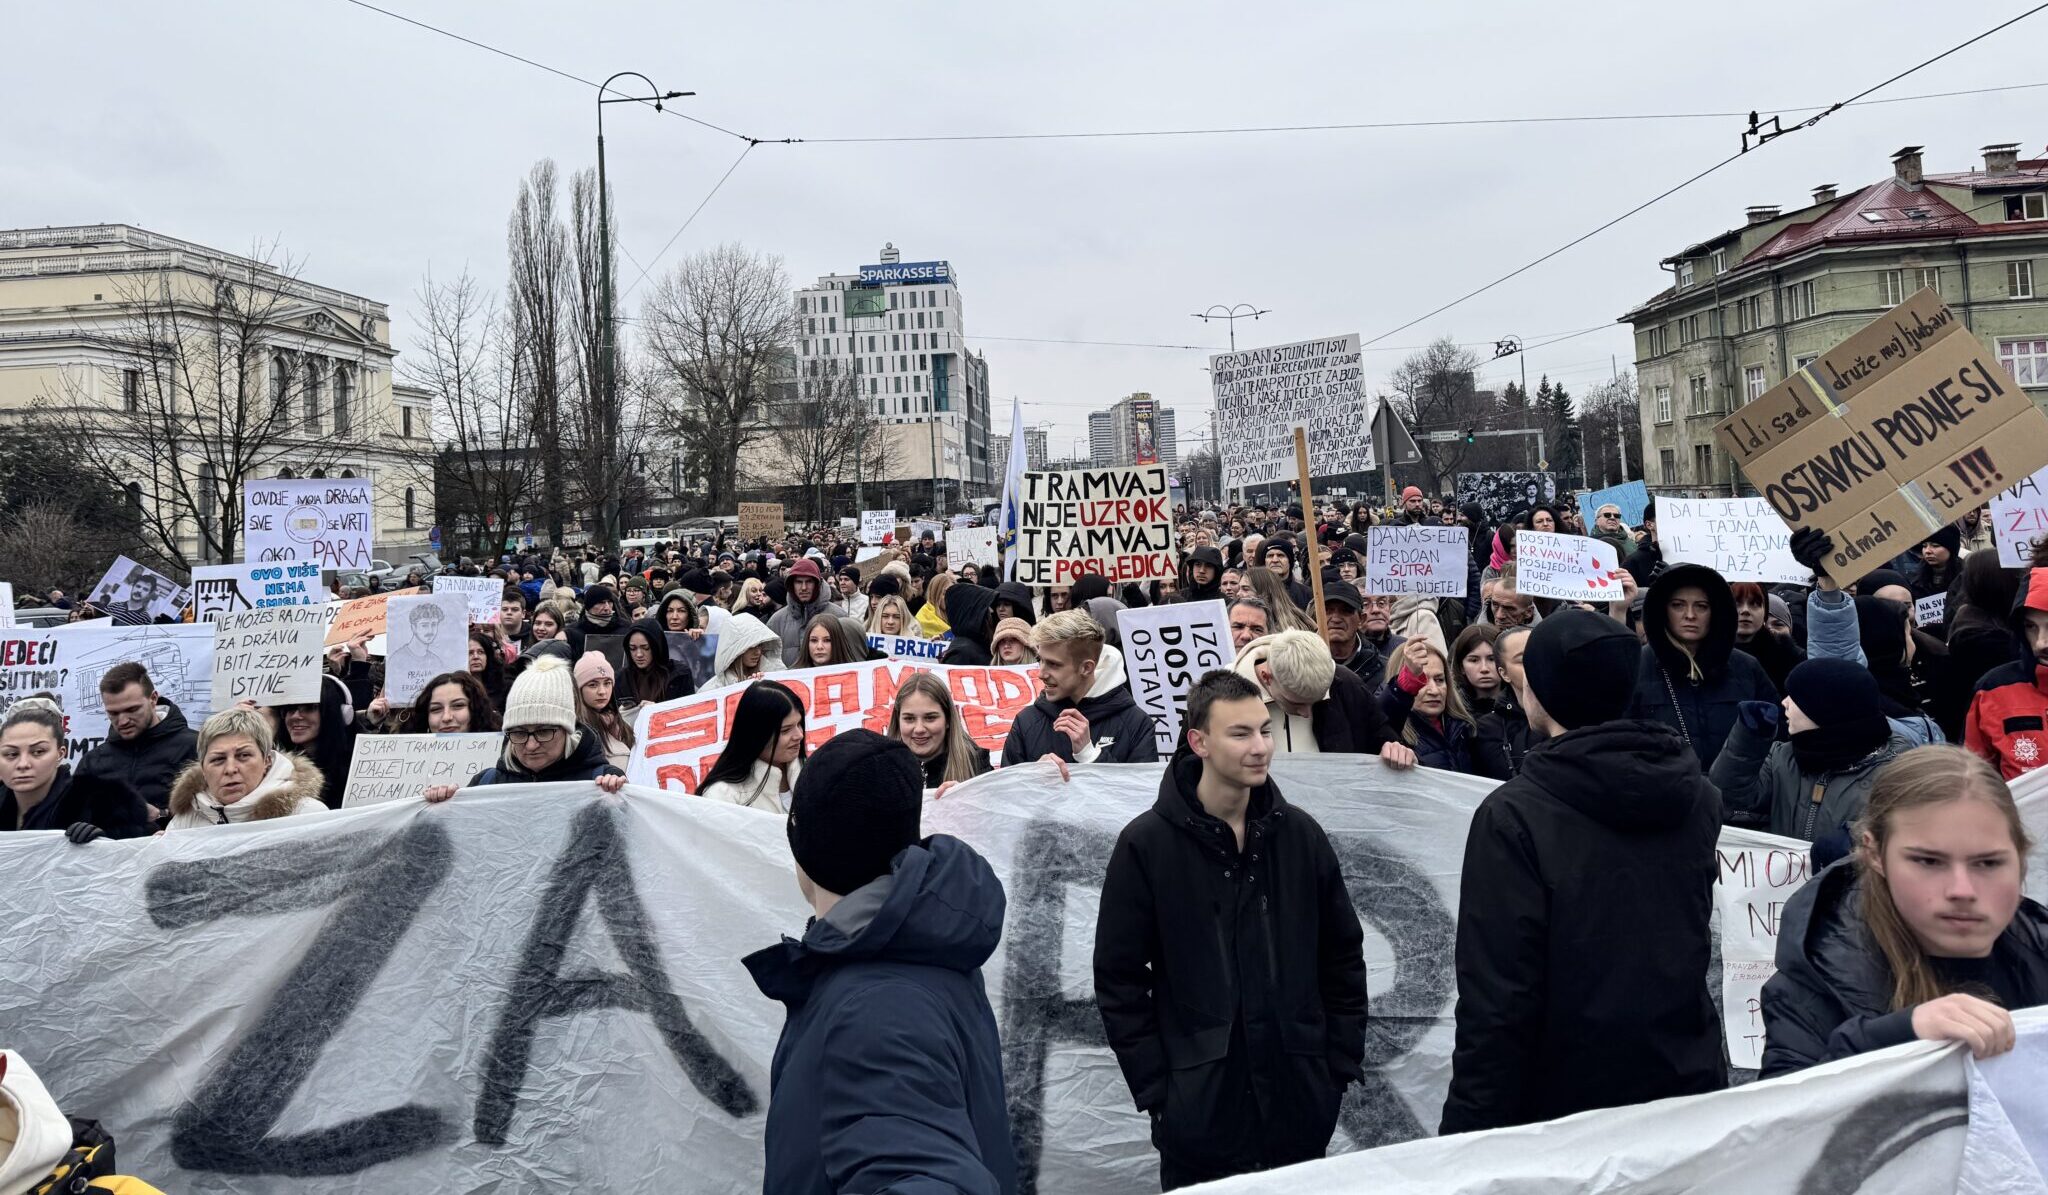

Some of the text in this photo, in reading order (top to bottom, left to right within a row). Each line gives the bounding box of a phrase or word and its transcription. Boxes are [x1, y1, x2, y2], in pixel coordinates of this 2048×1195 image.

[860, 267, 934, 282] SPARKASSE
[1273, 341, 1324, 363] STUDENTI
[1330, 339, 1347, 352] SVI
[1772, 387, 1812, 434] sad
[1825, 355, 1880, 392] druže
[1880, 335, 1904, 362] moj
[1898, 304, 1954, 353] ljubavi
[1268, 371, 1322, 390] PROTESTE
[1766, 358, 2005, 522] OSTAVKU PODNESI
[1024, 468, 1166, 500] TRAMVAJ
[1226, 462, 1281, 486] PRAVDU!
[252, 490, 288, 506] OVDJE
[326, 488, 368, 504] DRAGA
[1022, 497, 1168, 528] NIJE UZROK
[1670, 502, 1691, 518] DA
[1719, 502, 1736, 517] JE
[250, 515, 272, 530] SVE
[340, 512, 368, 532] VRTI
[1705, 519, 1760, 534] TAJNA
[1022, 524, 1170, 558] TRAMVAJ
[1520, 533, 1588, 552] DOSTA JE
[1705, 535, 1728, 553] JE
[1736, 535, 1790, 552] TAJNA
[1834, 512, 1897, 568] odmah
[314, 538, 372, 568] PARA
[1379, 548, 1440, 564] ERDOAN
[250, 562, 319, 580] OVO VIŠE
[1020, 559, 1052, 583] JE
[1387, 564, 1434, 576] SUTRA
[1518, 557, 1585, 574] POSLJEDICA
[1715, 552, 1766, 576] LAŽ?
[264, 580, 306, 596] NEMA
[1371, 578, 1458, 596] MOJE DIJETE!
[1520, 580, 1622, 599] NEODGOVORNOSTI
[1919, 602, 1931, 612] NA
[216, 616, 234, 632] NE
[278, 608, 322, 624] RADITI
[216, 629, 298, 650] ZA DRŽAVU
[224, 652, 252, 671] BITI
[254, 649, 314, 669] ŽEDAN
[230, 672, 292, 698] ISTINE
[360, 740, 398, 755] STARI
[432, 762, 454, 778] DA
[348, 782, 431, 802] REKLAMIR
[1716, 849, 1756, 888] MI
[1726, 962, 1759, 971] PRAVDA
[145, 802, 758, 1177] ZA
